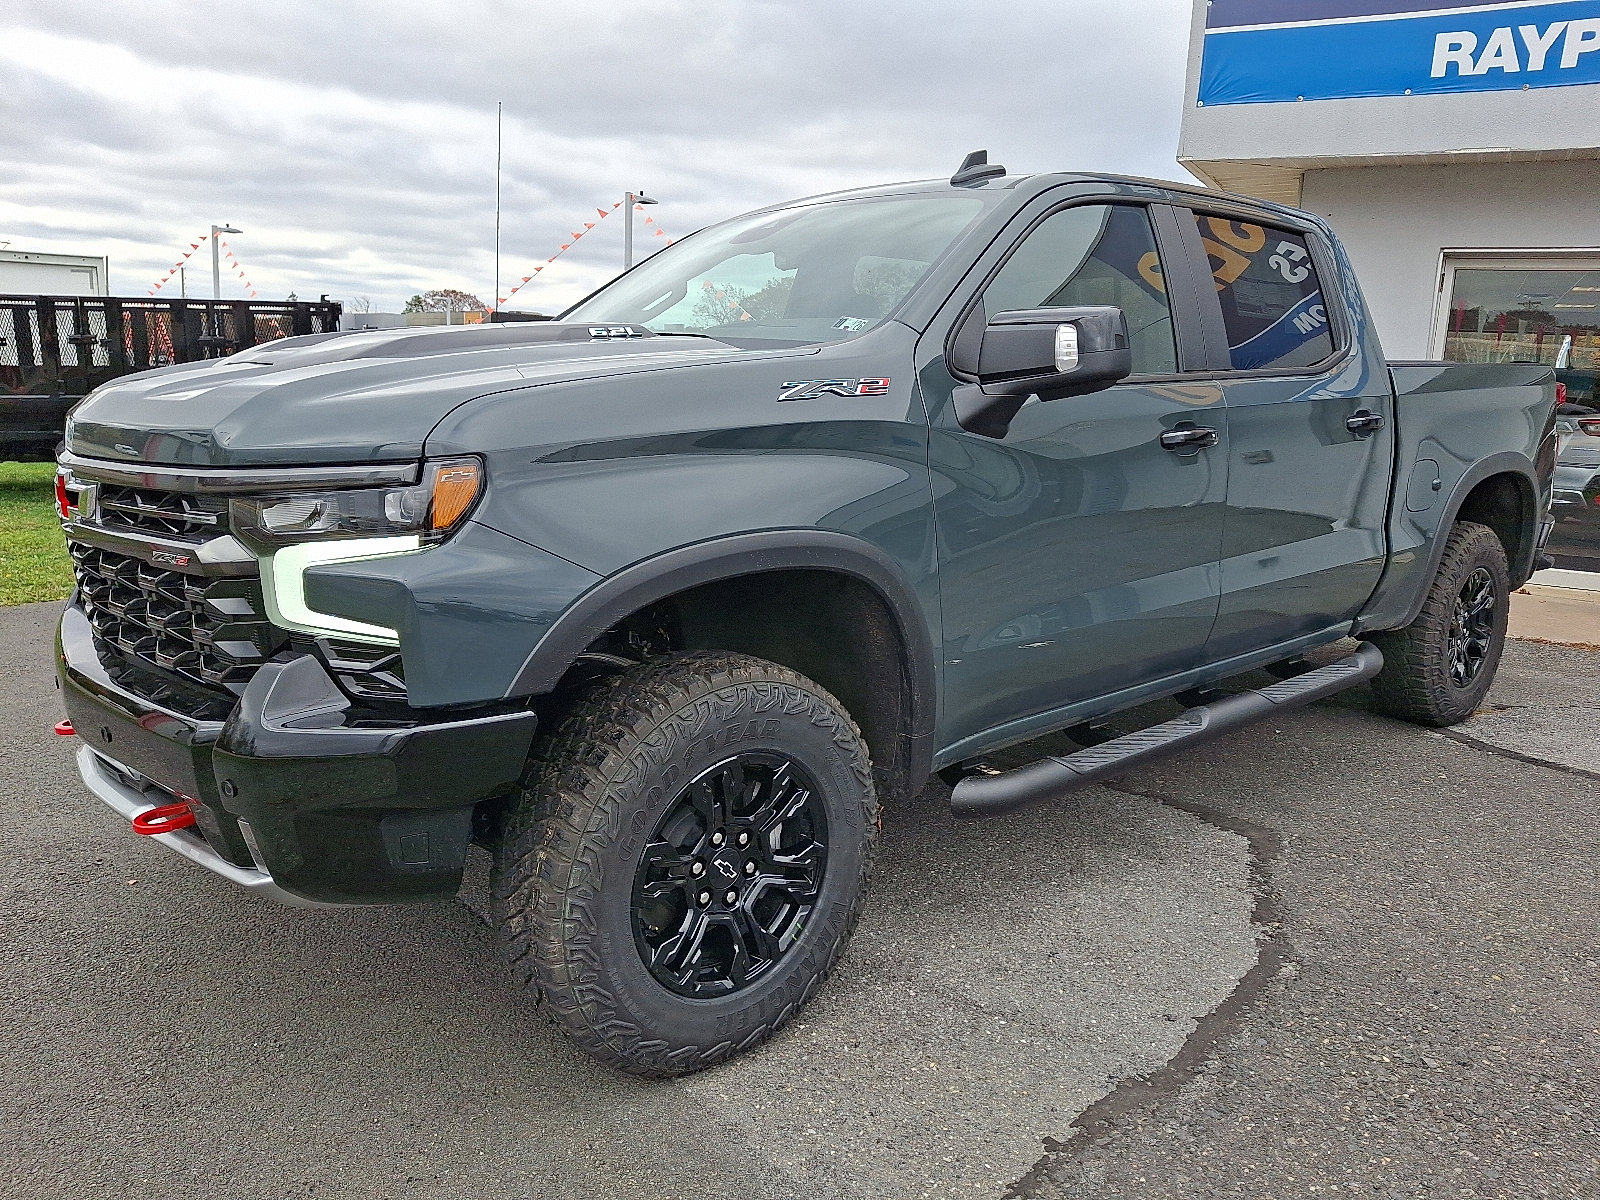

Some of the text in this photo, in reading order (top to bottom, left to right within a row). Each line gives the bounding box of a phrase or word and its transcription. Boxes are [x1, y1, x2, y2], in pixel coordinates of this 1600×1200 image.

[1431, 18, 1600, 78] RAYP
[777, 377, 891, 402] ZR2
[152, 550, 190, 567] ZR2
[715, 901, 848, 1037] WRANGLER
